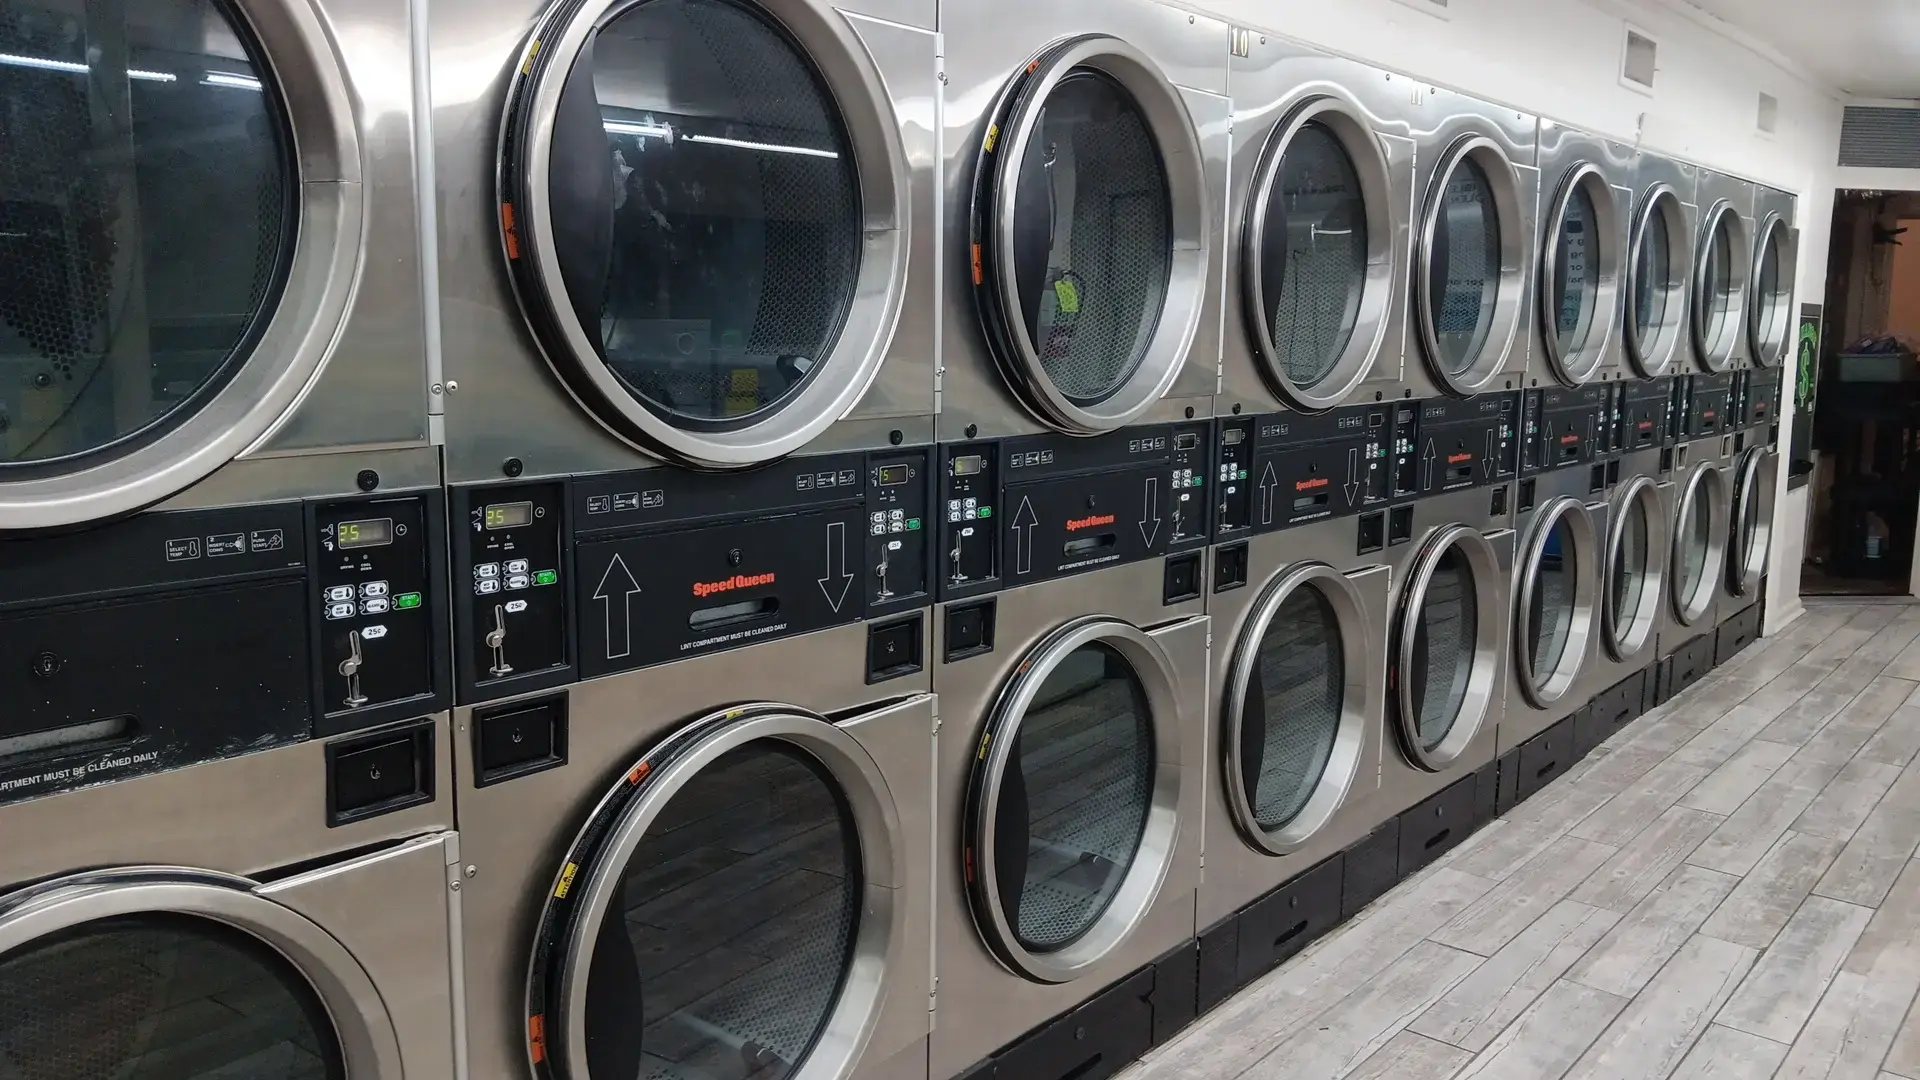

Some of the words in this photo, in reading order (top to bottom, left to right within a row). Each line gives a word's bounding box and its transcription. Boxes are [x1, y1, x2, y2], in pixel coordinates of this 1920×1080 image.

[1232, 28, 1248, 56] 10
[1066, 517, 1090, 531] Speed
[693, 577, 735, 597] Speed
[736, 573, 775, 588] Queen
[680, 642, 692, 651] LINT
[692, 635, 729, 648] COMPARTMENT
[730, 631, 744, 640] MUST
[751, 626, 774, 636] CLEANED
[774, 623, 788, 631] DAILY
[44, 769, 71, 782] MUST
[72, 765, 86, 776] BE
[88, 756, 132, 773] CLEANED
[133, 750, 159, 764] DAILY
